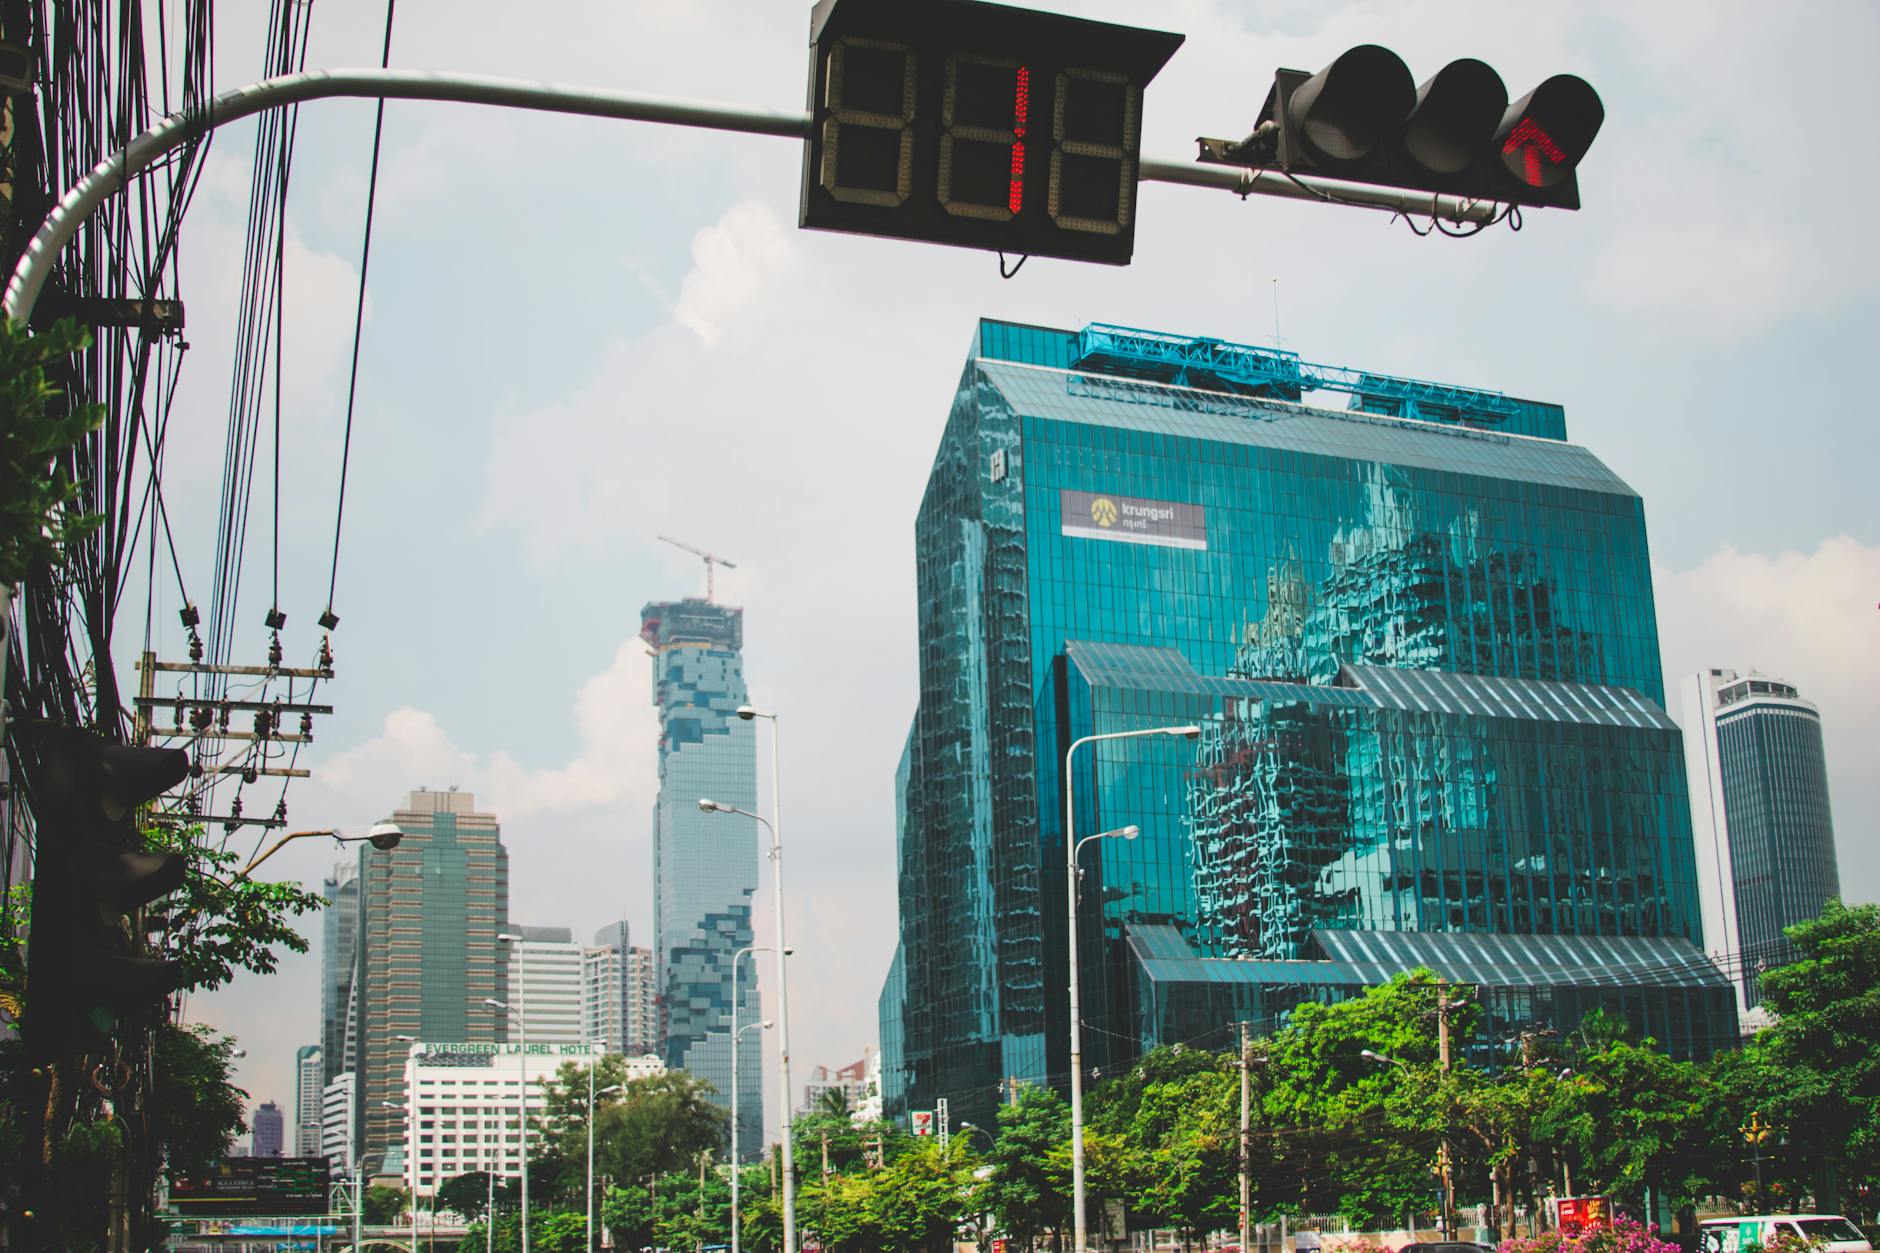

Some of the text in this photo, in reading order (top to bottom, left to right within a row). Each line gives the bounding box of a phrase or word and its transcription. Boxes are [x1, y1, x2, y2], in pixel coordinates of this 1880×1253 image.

[1122, 503, 1173, 520] krungsri
[426, 1043, 500, 1055] EVERGREEN
[506, 1043, 553, 1055] LAUREL
